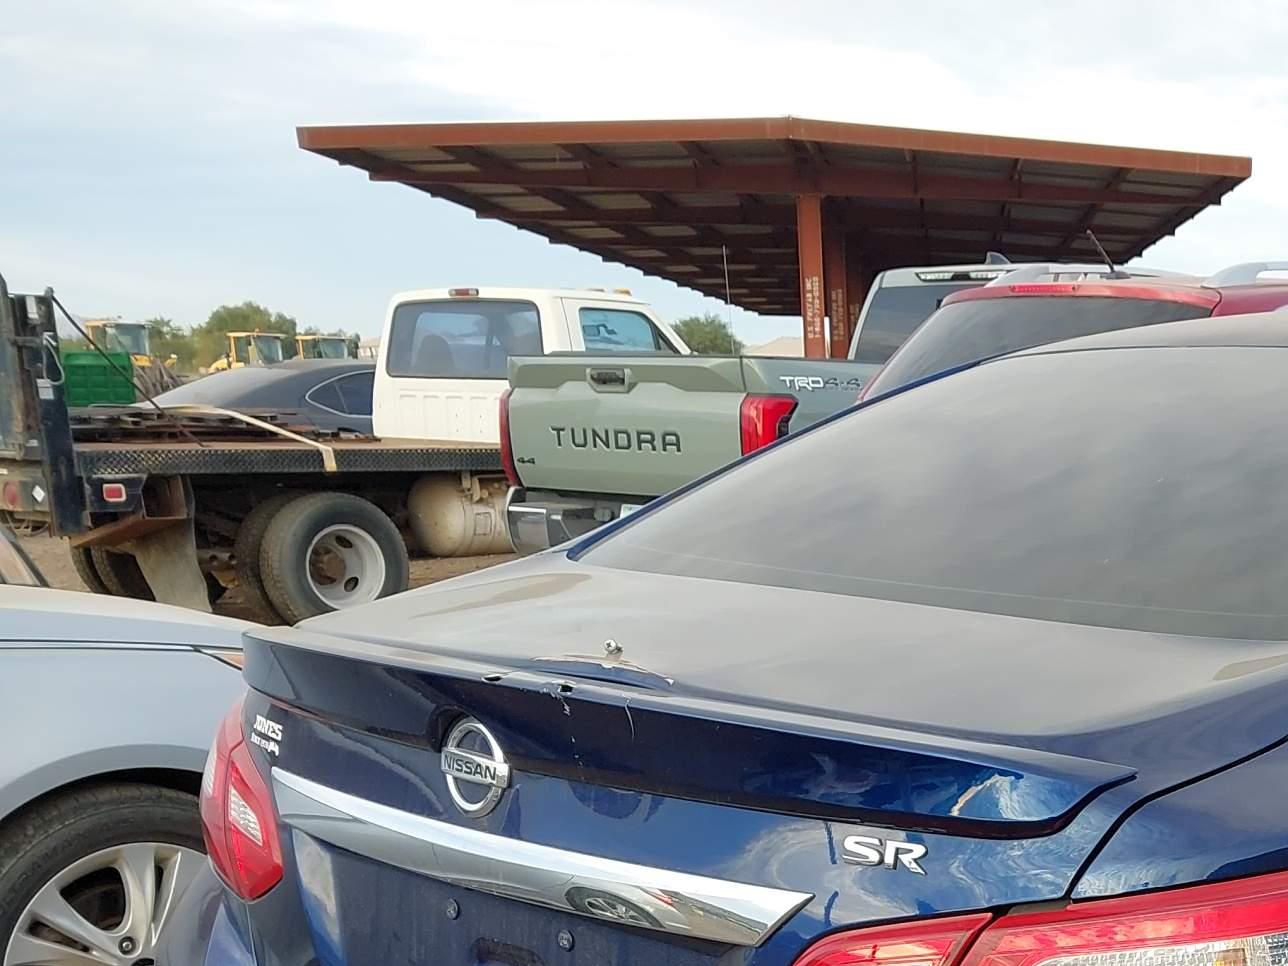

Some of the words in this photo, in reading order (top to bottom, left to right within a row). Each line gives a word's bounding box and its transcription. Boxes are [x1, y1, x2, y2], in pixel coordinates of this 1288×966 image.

[779, 375, 825, 391] TRD
[549, 425, 683, 454] TUNDRA
[253, 714, 283, 741] JONES
[443, 754, 497, 781] NISSAN
[842, 835, 928, 876] SR
